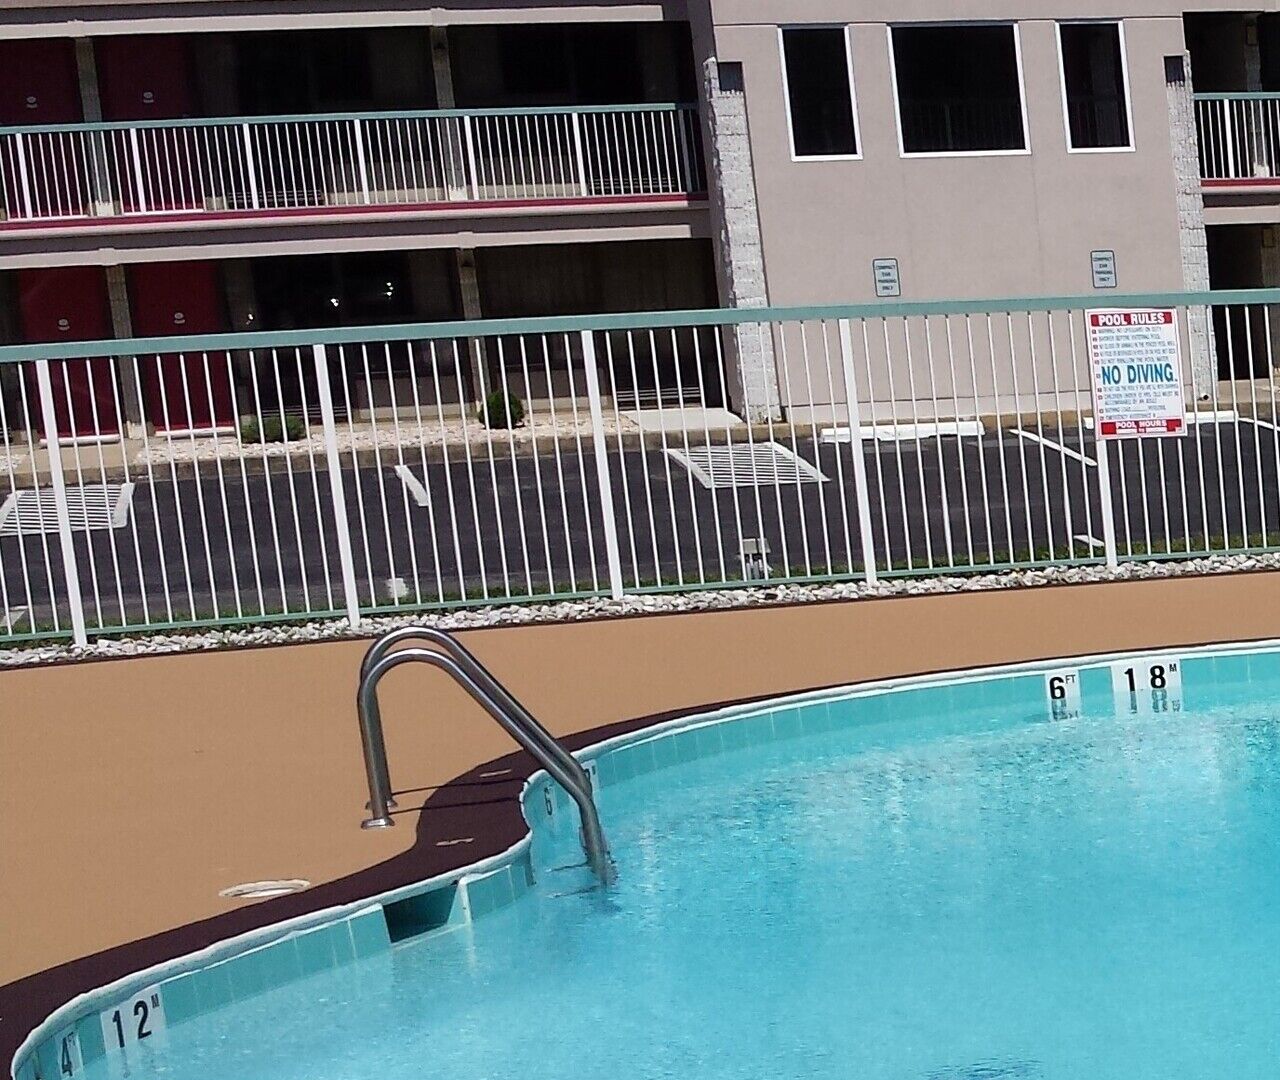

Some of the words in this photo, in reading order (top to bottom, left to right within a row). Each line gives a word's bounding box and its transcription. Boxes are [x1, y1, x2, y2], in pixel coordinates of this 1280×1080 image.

[1098, 314, 1127, 326] POOL
[1130, 312, 1165, 325] RULES
[1101, 365, 1121, 385] NO
[1116, 421, 1138, 429] POOL
